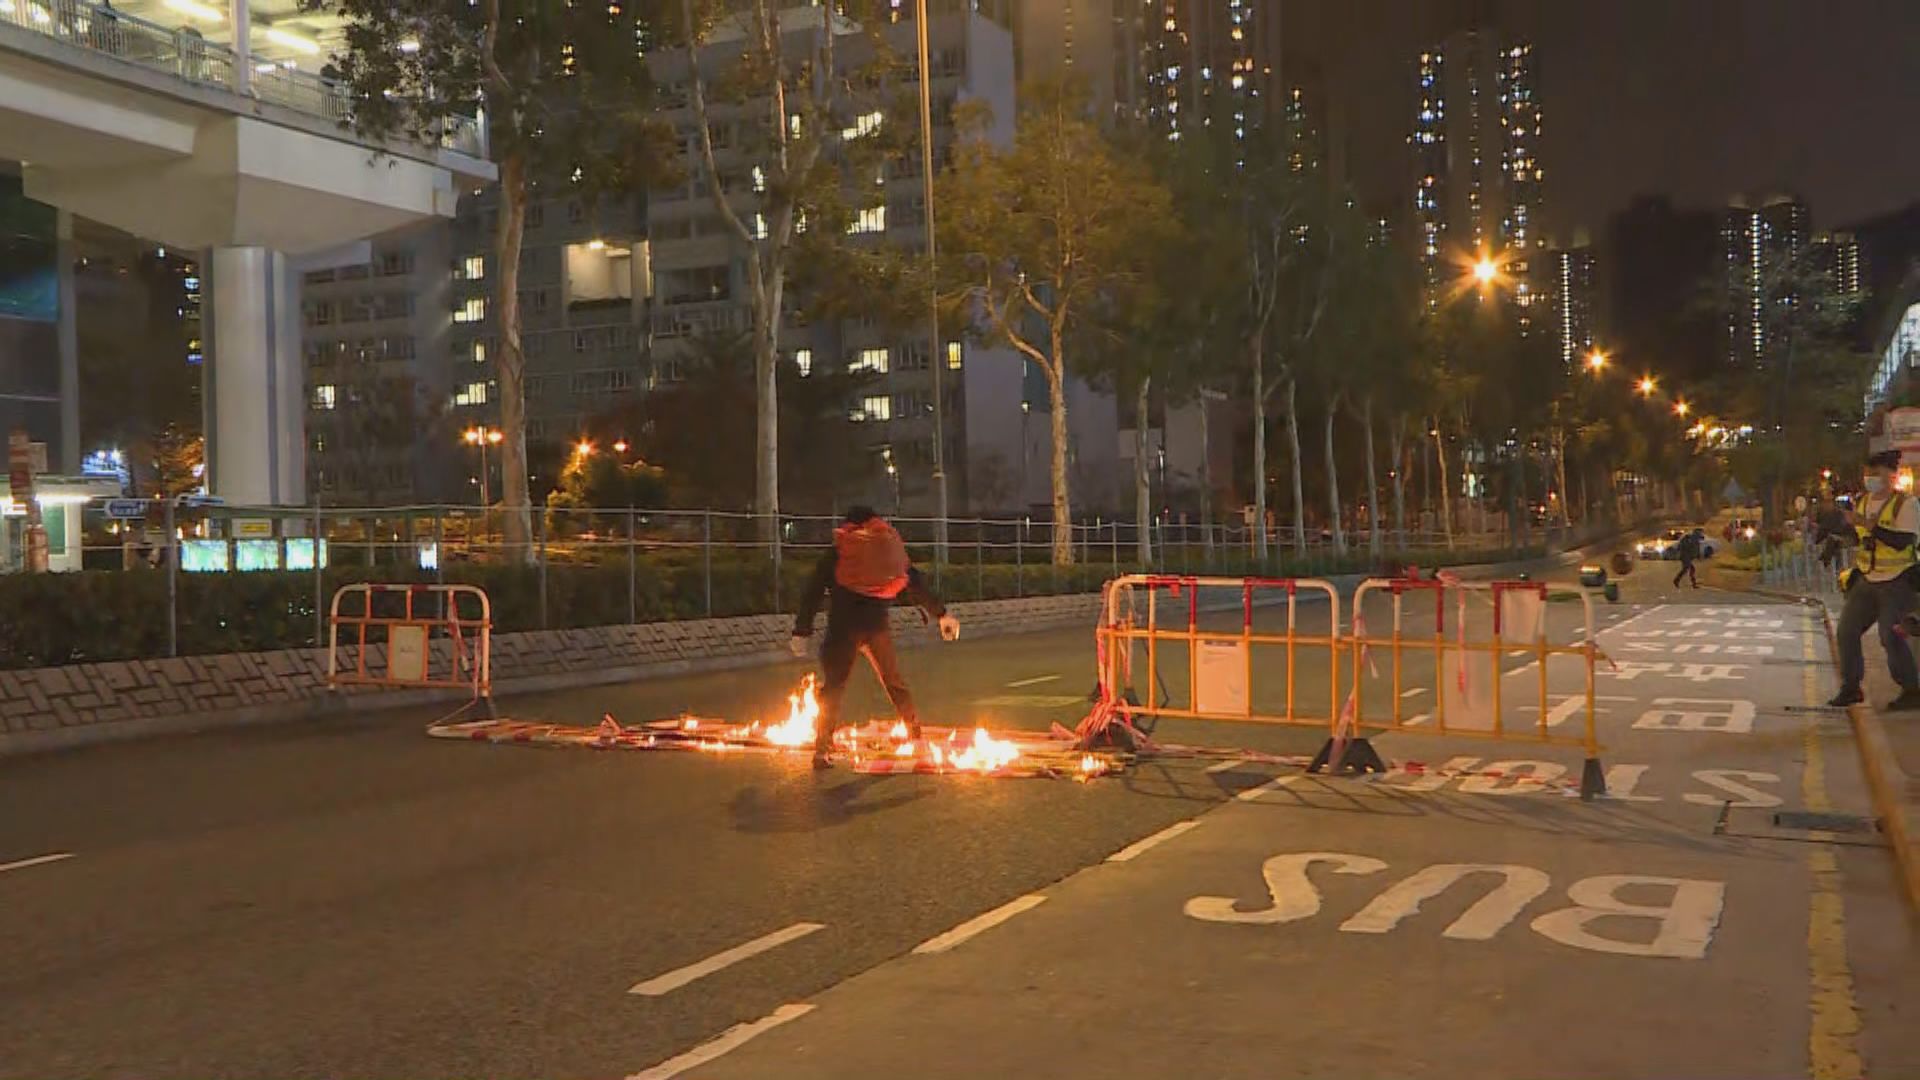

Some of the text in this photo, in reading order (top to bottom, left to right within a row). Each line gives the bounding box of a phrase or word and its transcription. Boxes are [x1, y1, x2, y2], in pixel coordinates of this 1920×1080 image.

[1516, 697, 1757, 734] 巴士
[1365, 756, 1782, 808] STOP
[1184, 852, 1726, 960] BUS
